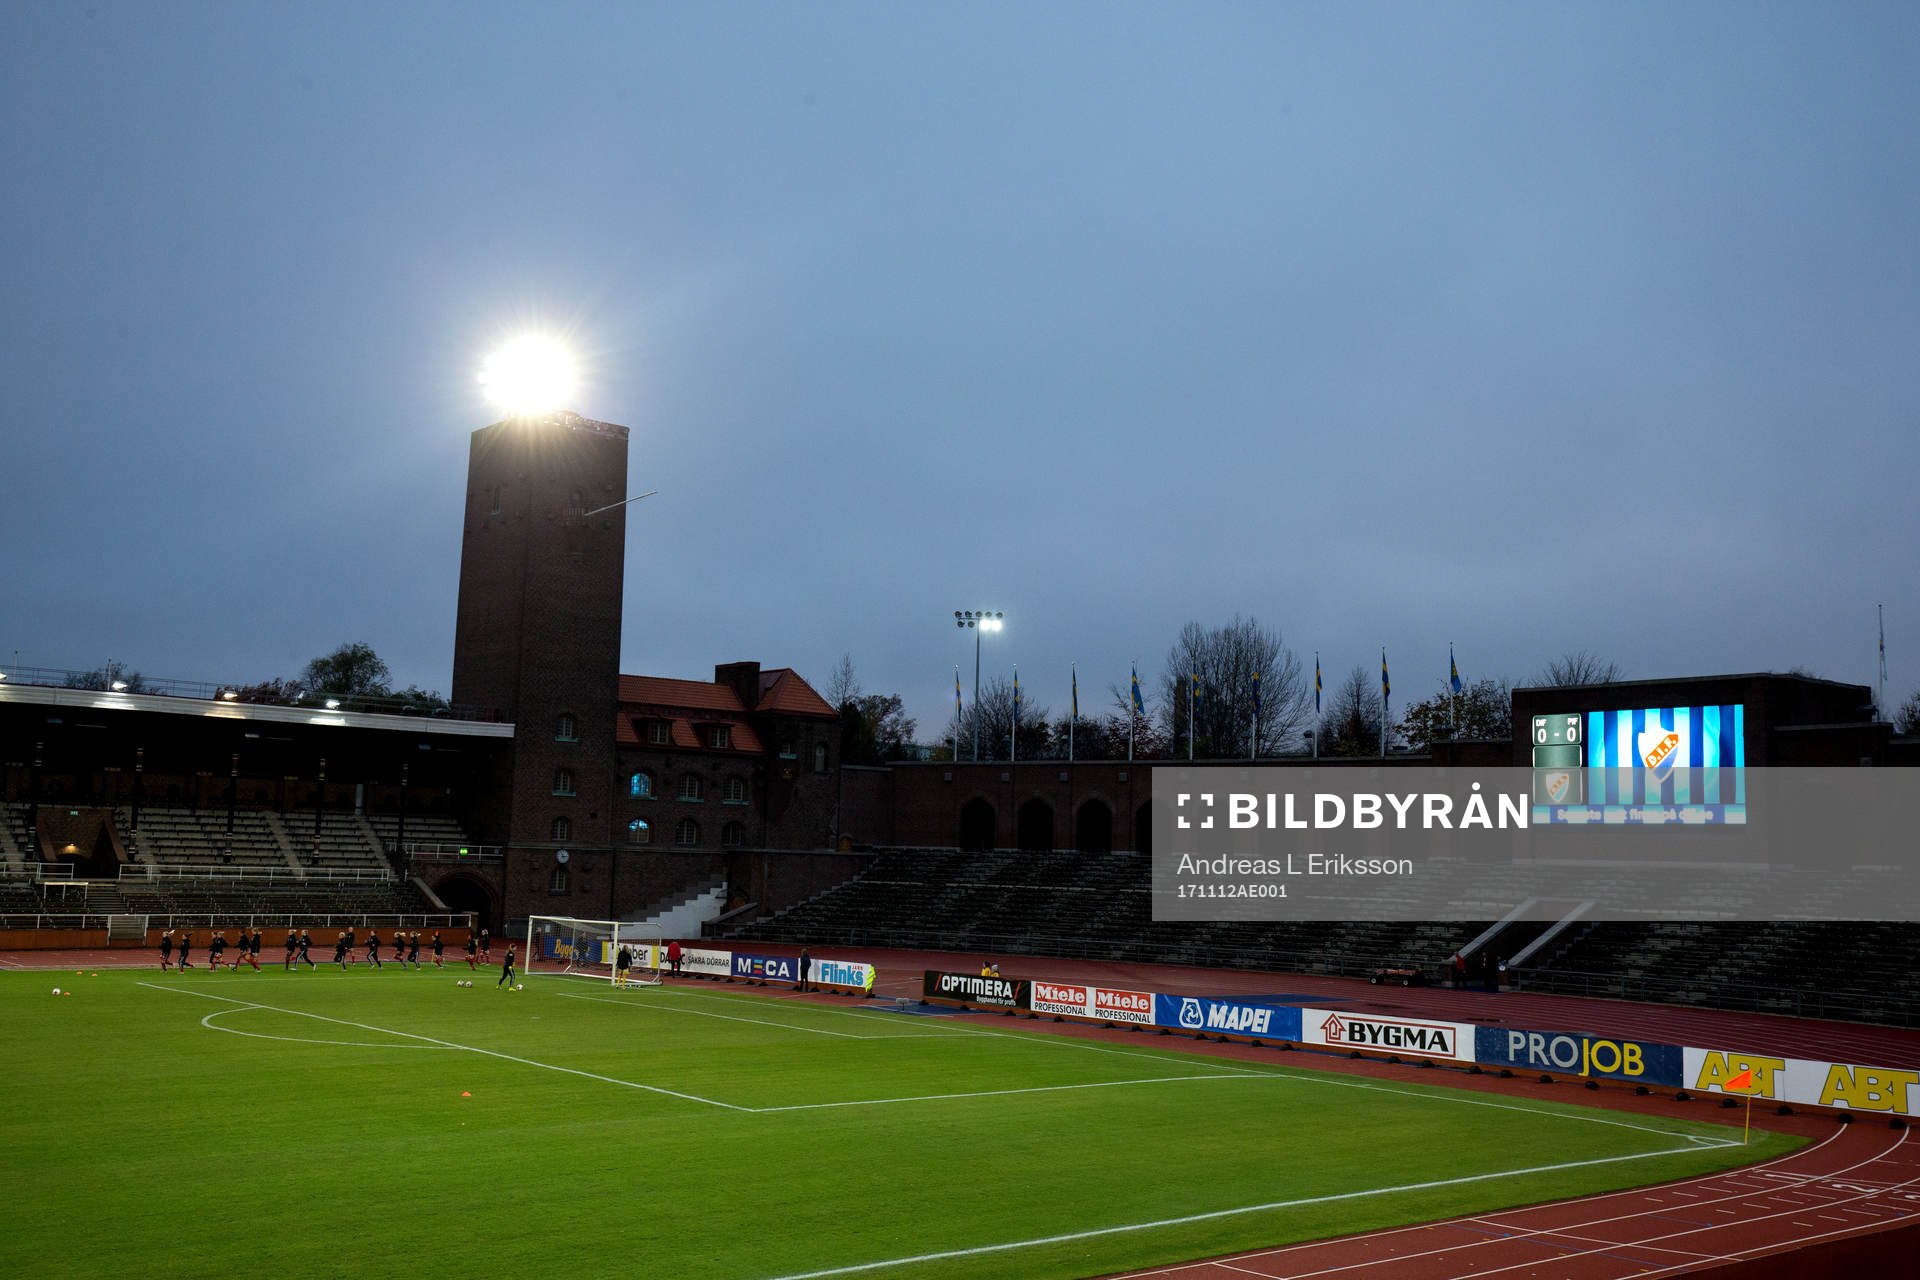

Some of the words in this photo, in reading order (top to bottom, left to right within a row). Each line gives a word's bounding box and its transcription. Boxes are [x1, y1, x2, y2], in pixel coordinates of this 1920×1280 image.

[1538, 728, 1546, 744] 0
[1566, 727, 1576, 742] 0
[737, 957, 790, 978] MECA
[821, 962, 864, 986] Flinks
[941, 975, 1013, 999] OPTIMERA
[1036, 984, 1086, 1004] Miele
[1034, 1002, 1087, 1016] PROFESSIONAL
[1096, 990, 1150, 1010] Miele
[1095, 1009, 1151, 1024] PROFESSIONAL
[1207, 1004, 1272, 1034] MAPEI
[1348, 1022, 1450, 1052] BYGMA
[1508, 1030, 1645, 1077] PROJOB
[1695, 1050, 1785, 1098] ABT
[1818, 1064, 1920, 1114] ABT
